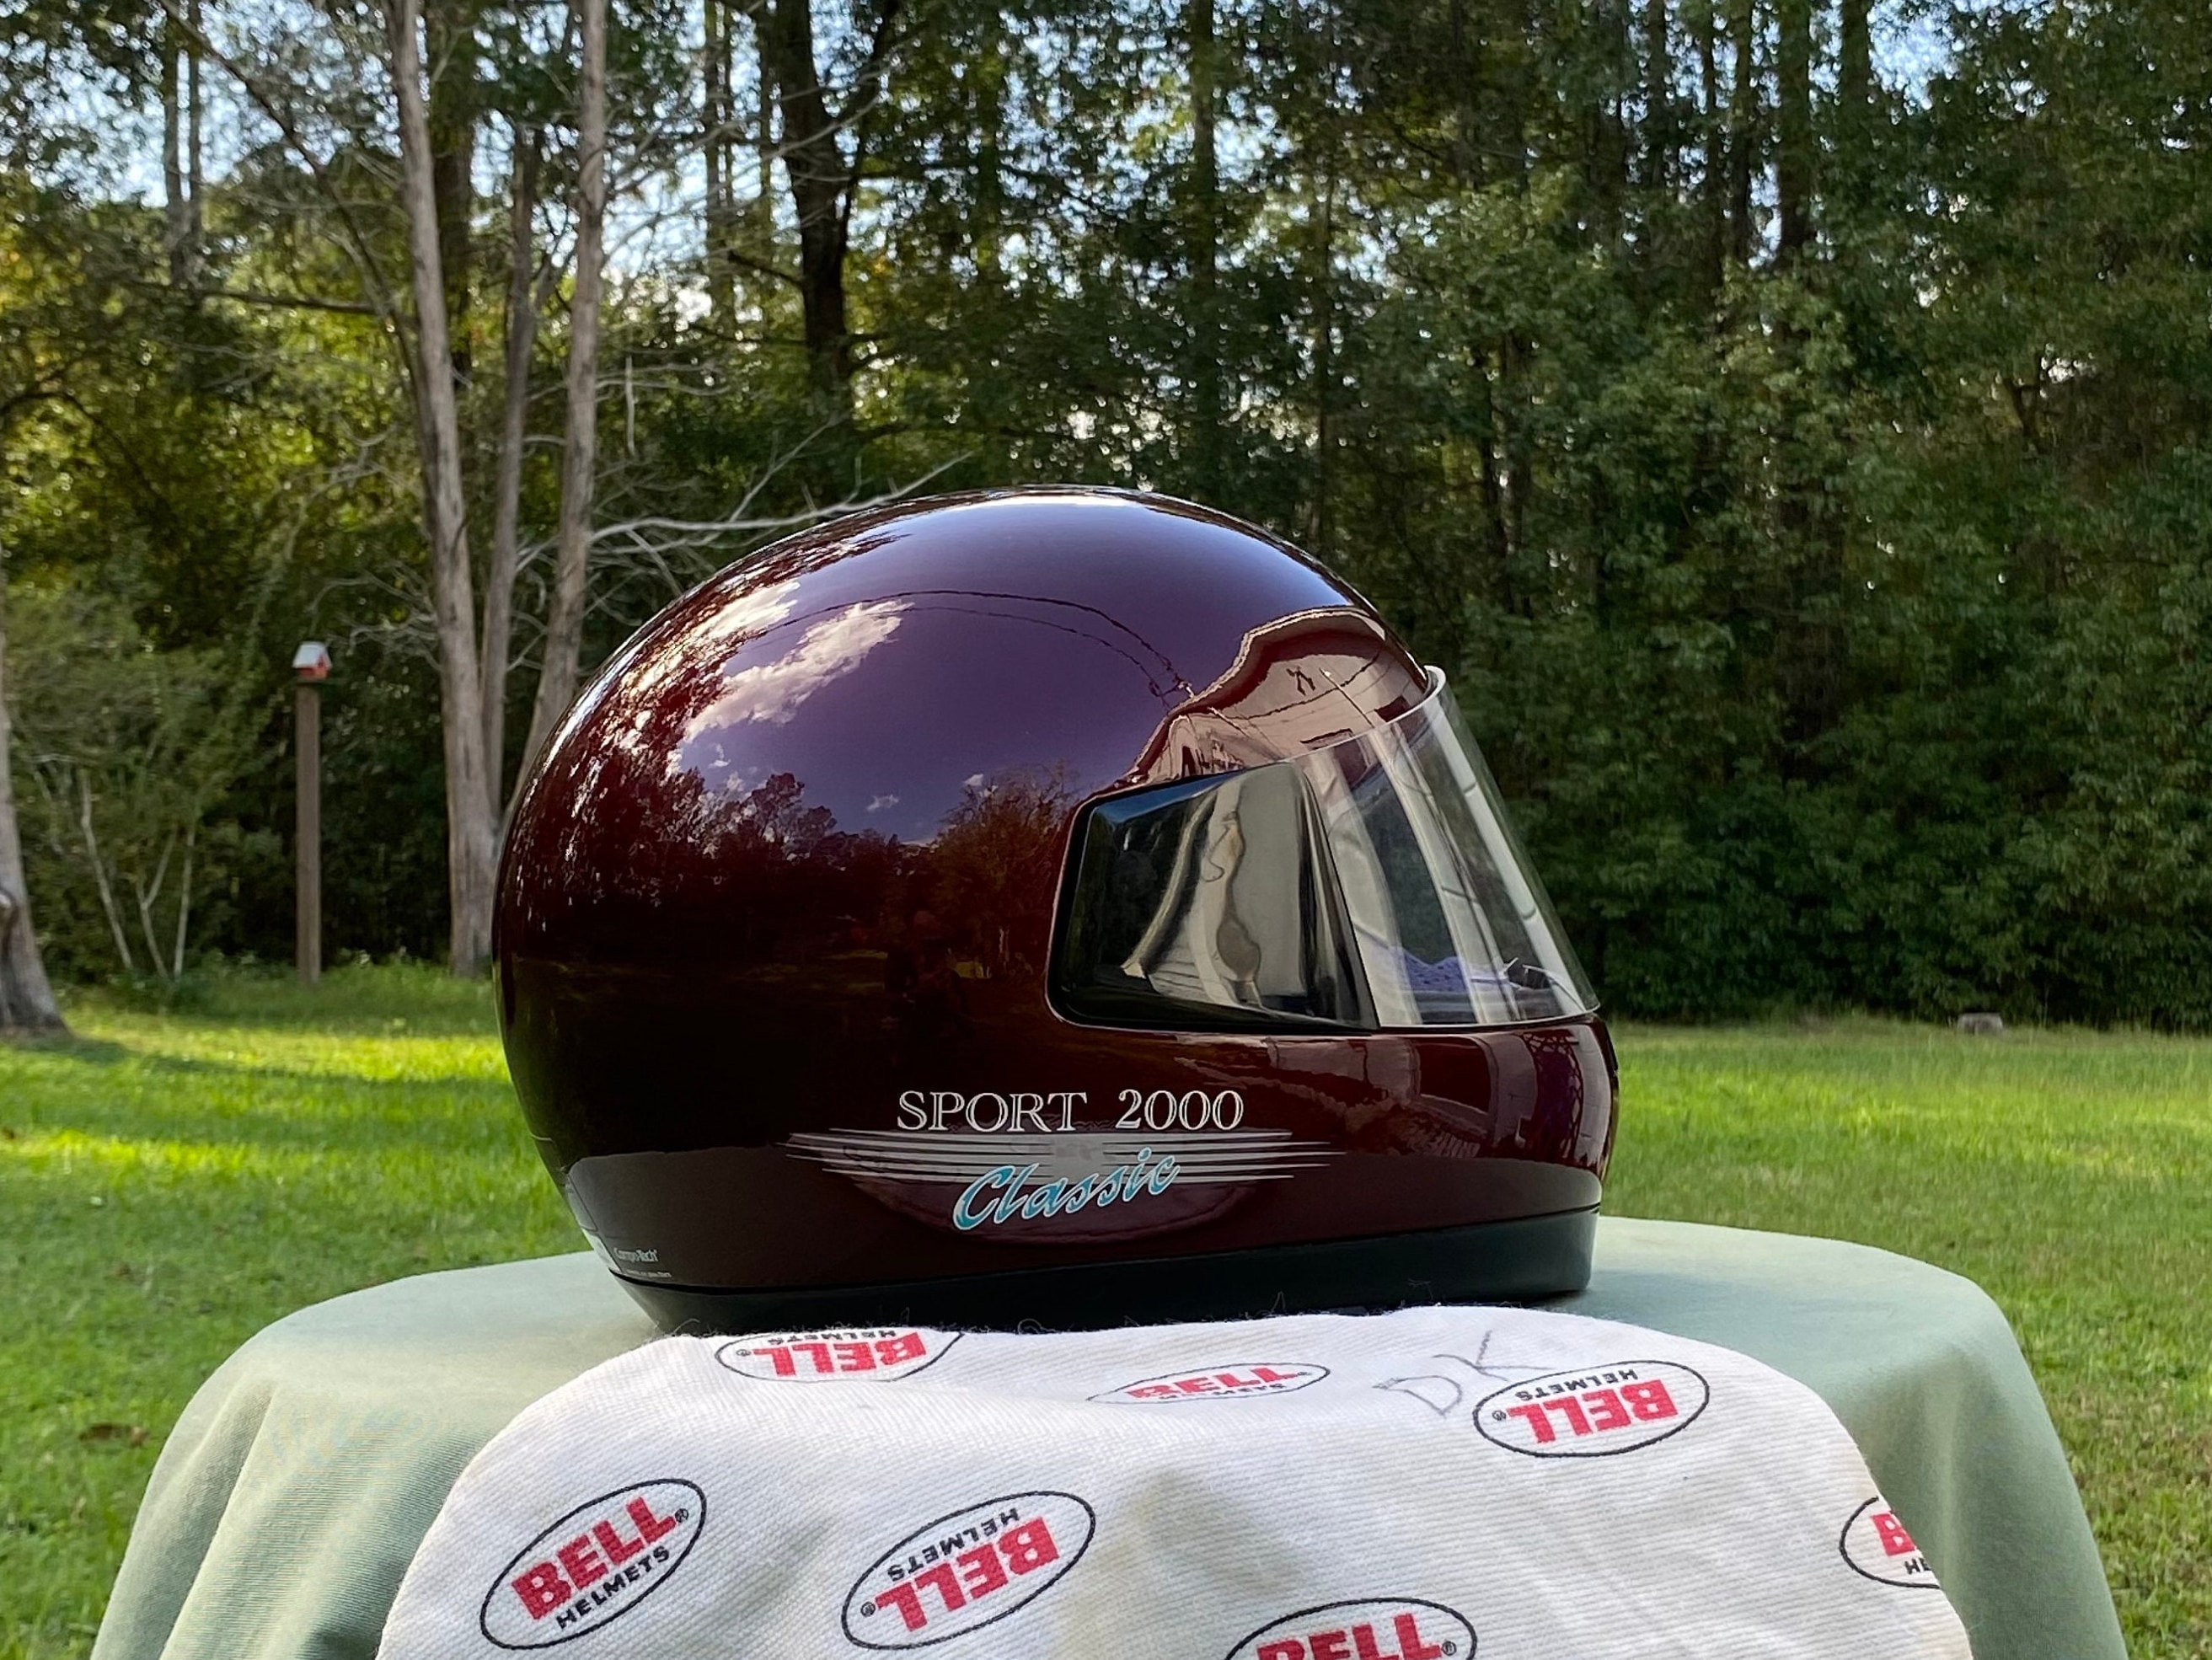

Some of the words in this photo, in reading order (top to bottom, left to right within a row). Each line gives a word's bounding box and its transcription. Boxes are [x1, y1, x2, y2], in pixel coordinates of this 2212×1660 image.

[897, 1090, 1088, 1133] SPORT
[1115, 1089, 1245, 1131] 2000
[952, 1146, 1181, 1231] Classic
[1515, 1368, 1640, 1402] HELMETS
[886, 1507, 1020, 1582] HELMETS
[554, 1545, 671, 1631] HELMETS
